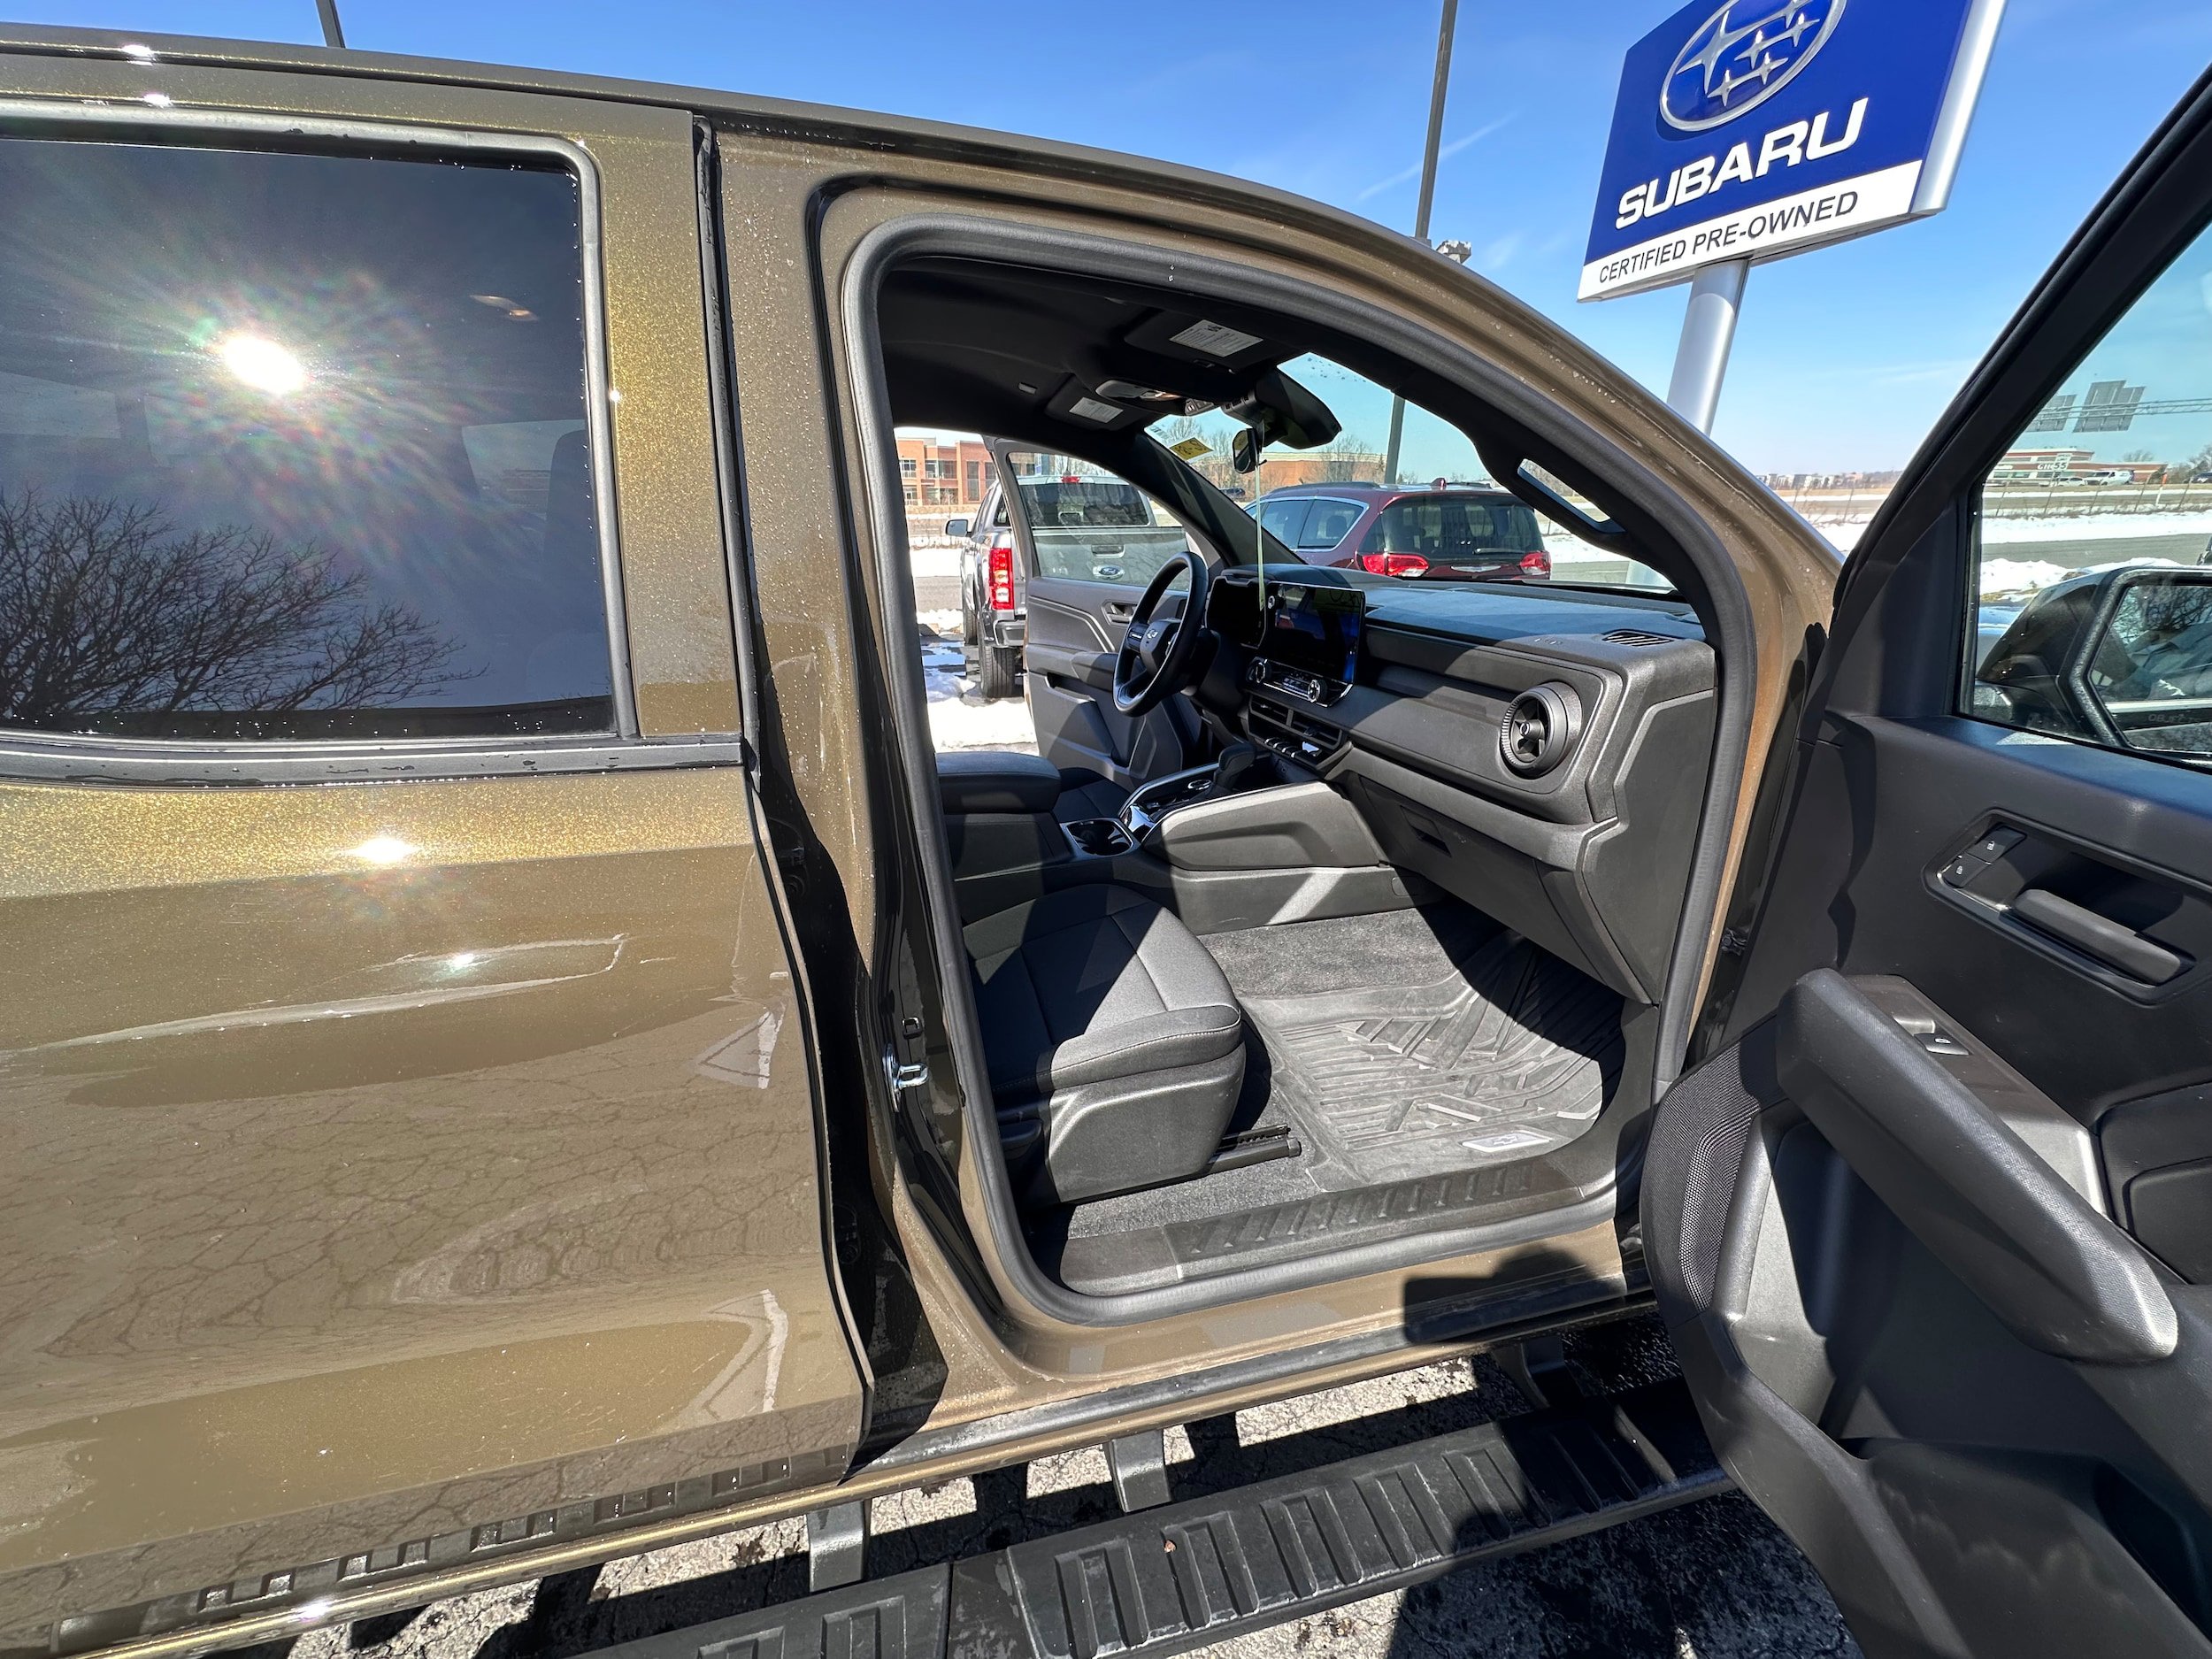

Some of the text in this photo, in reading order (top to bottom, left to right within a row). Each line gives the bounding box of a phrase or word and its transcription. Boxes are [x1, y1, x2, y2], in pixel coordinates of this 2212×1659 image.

[1616, 98, 1868, 229] SUBARU
[1599, 191, 1858, 283] CERTIFIED PRE-OWNED
